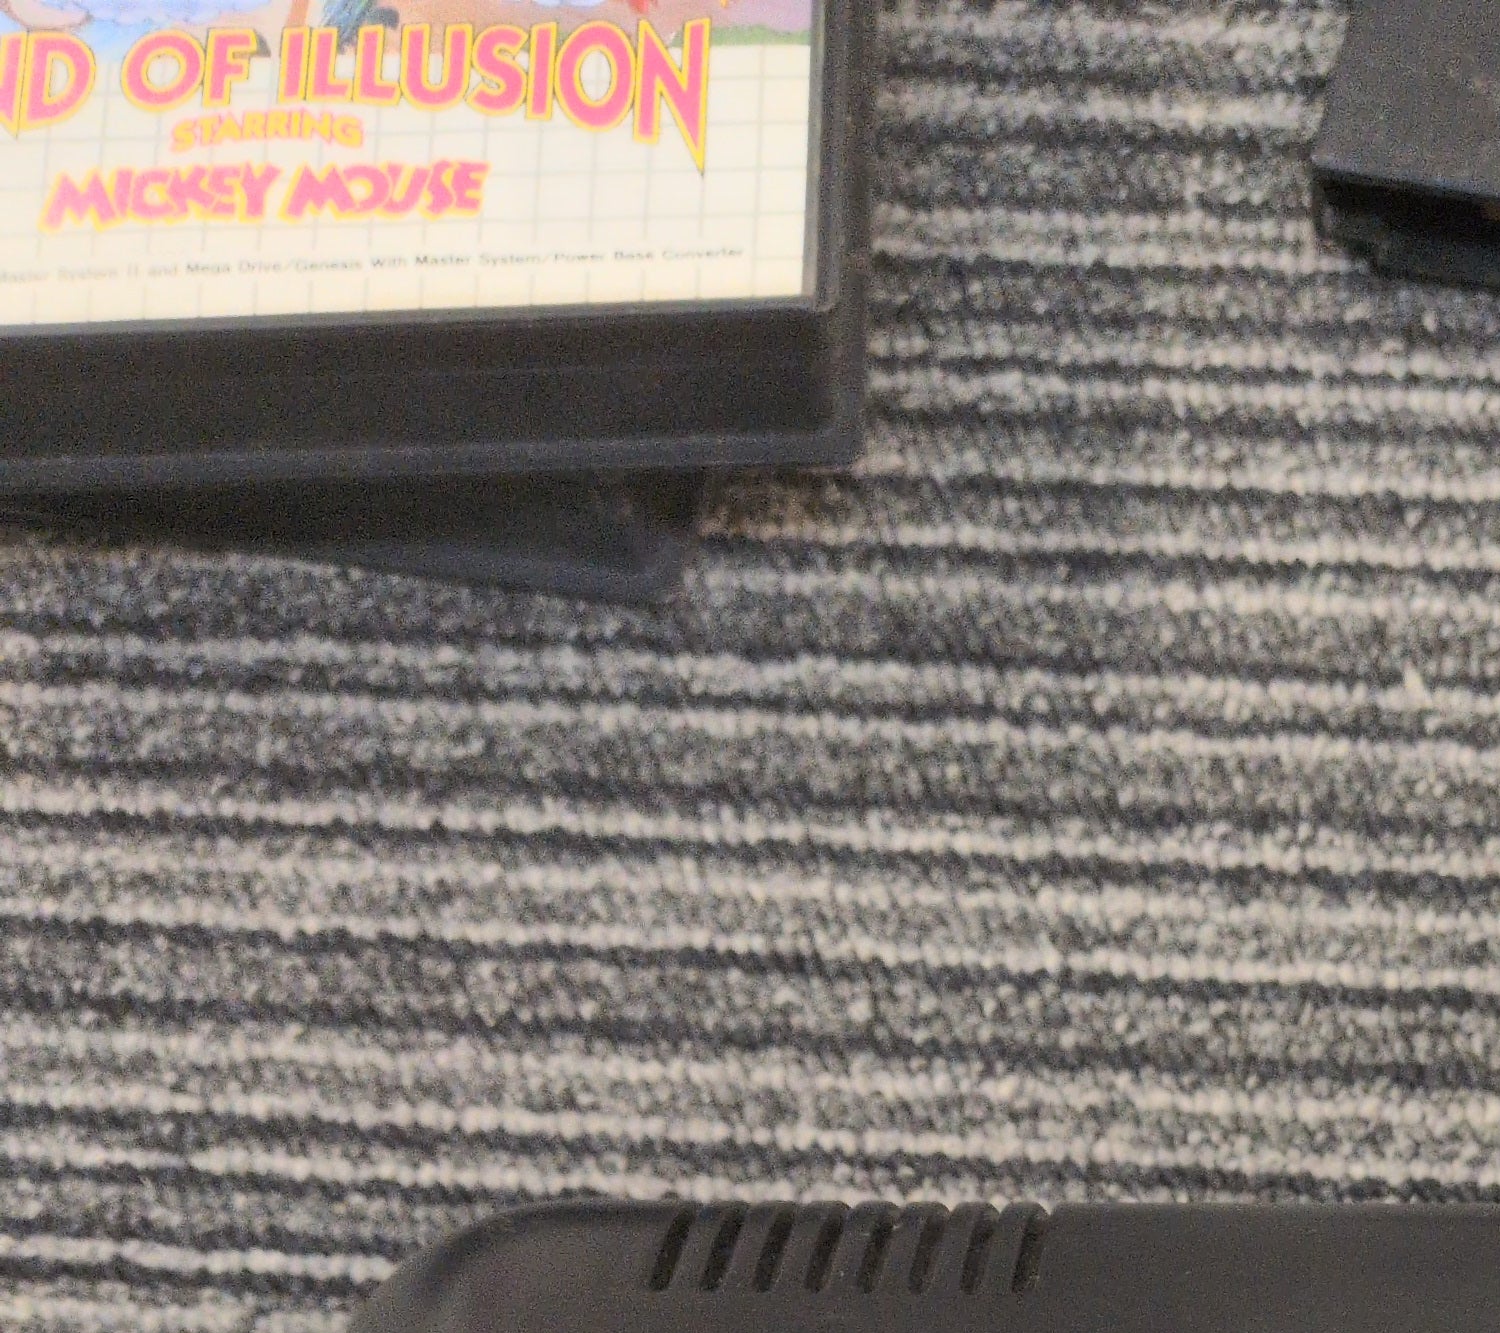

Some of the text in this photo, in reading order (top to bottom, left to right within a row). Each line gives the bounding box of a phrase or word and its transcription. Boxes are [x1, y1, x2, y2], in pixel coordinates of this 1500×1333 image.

[120, 27, 258, 112] OF
[277, 18, 711, 177] ILLUSION
[168, 108, 364, 153] STARRING
[37, 158, 491, 233] MICKEY MOUSE
[414, 253, 470, 267] Master
[662, 246, 744, 261] Converter
